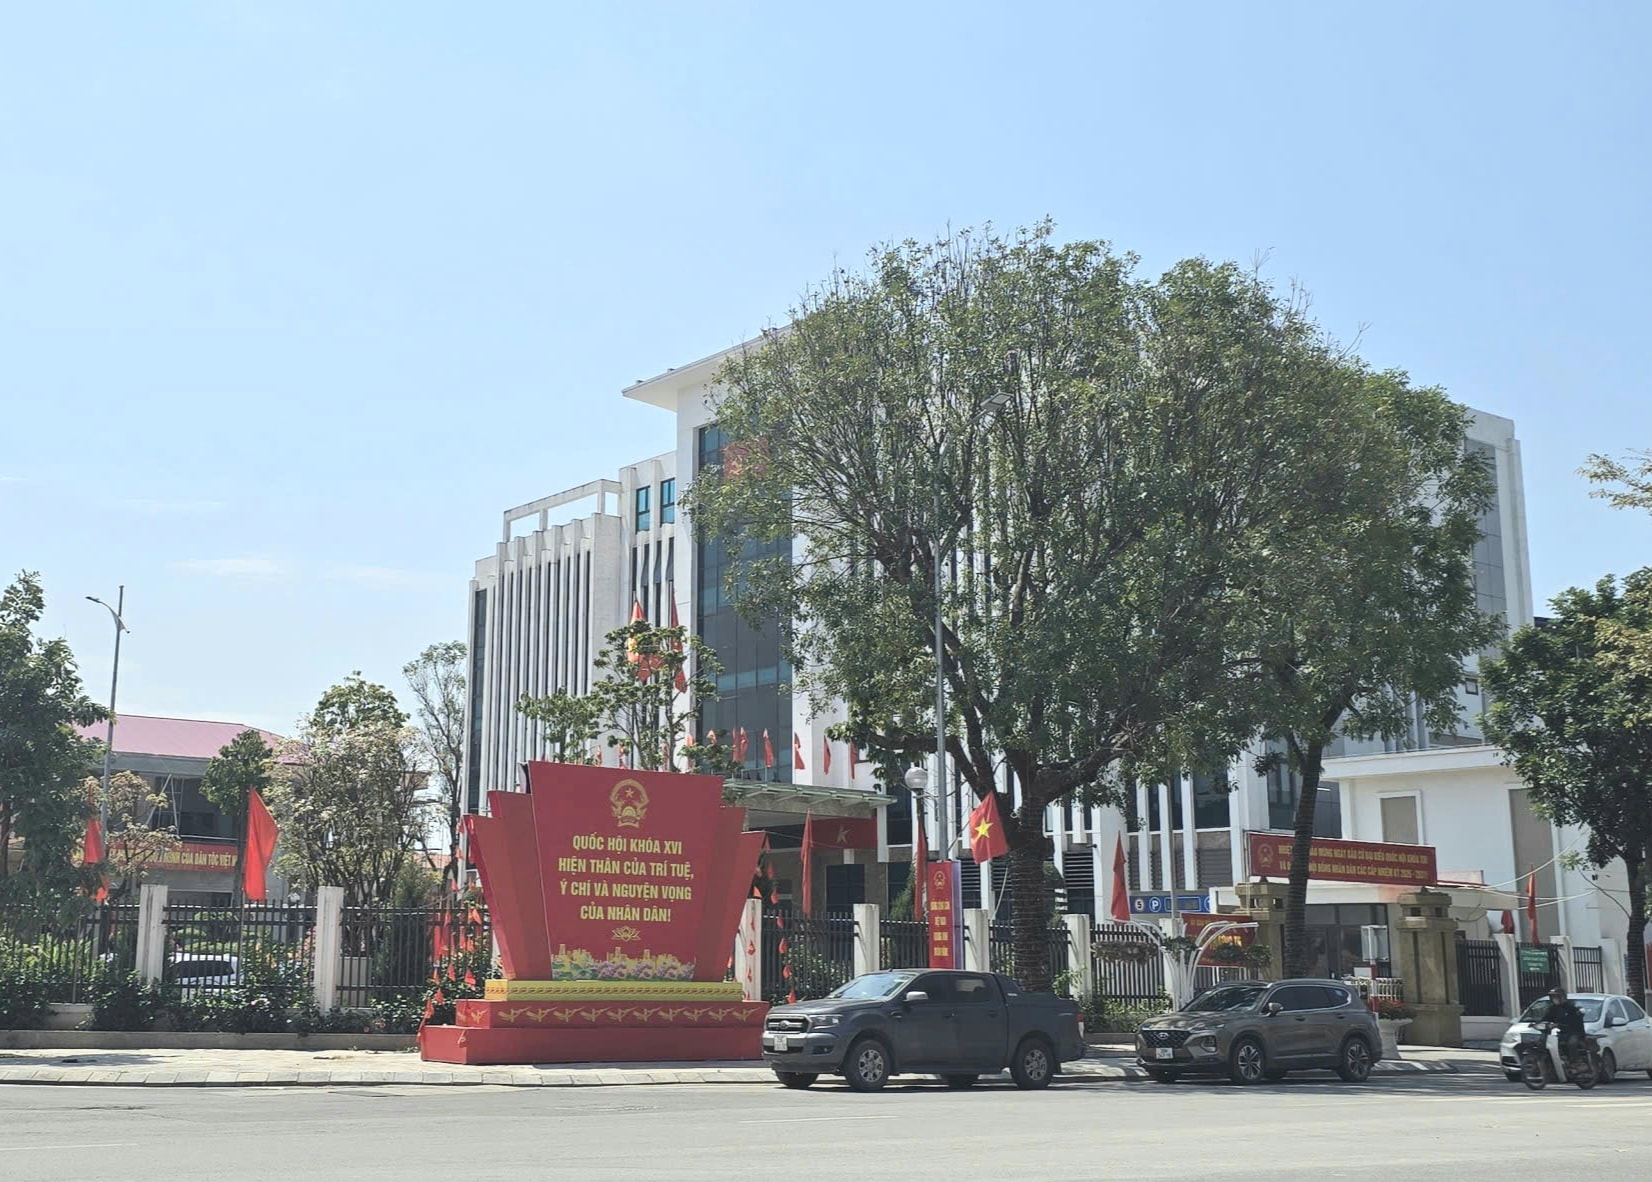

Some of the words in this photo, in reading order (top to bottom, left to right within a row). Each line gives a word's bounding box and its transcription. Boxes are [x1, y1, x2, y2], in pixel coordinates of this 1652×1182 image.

[572, 832, 604, 850] QUỐC
[607, 835, 626, 854] HỘI
[630, 837, 661, 854] KHÓA
[664, 841, 682, 854] XVI
[558, 856, 586, 875] HIỆN
[590, 857, 620, 874] THÂN
[624, 857, 646, 875] CỦA
[650, 860, 667, 876] TRÍ
[670, 862, 694, 880] TUỆ,
[560, 878, 568, 895] Ý
[571, 880, 590, 896] CHÍ
[594, 880, 609, 896] VÀ
[612, 882, 658, 901] NGUYỆN
[662, 886, 692, 902] VỌNG
[580, 901, 604, 920] CỦA
[608, 904, 640, 920] NHÂN
[643, 905, 671, 922] DÂN!
